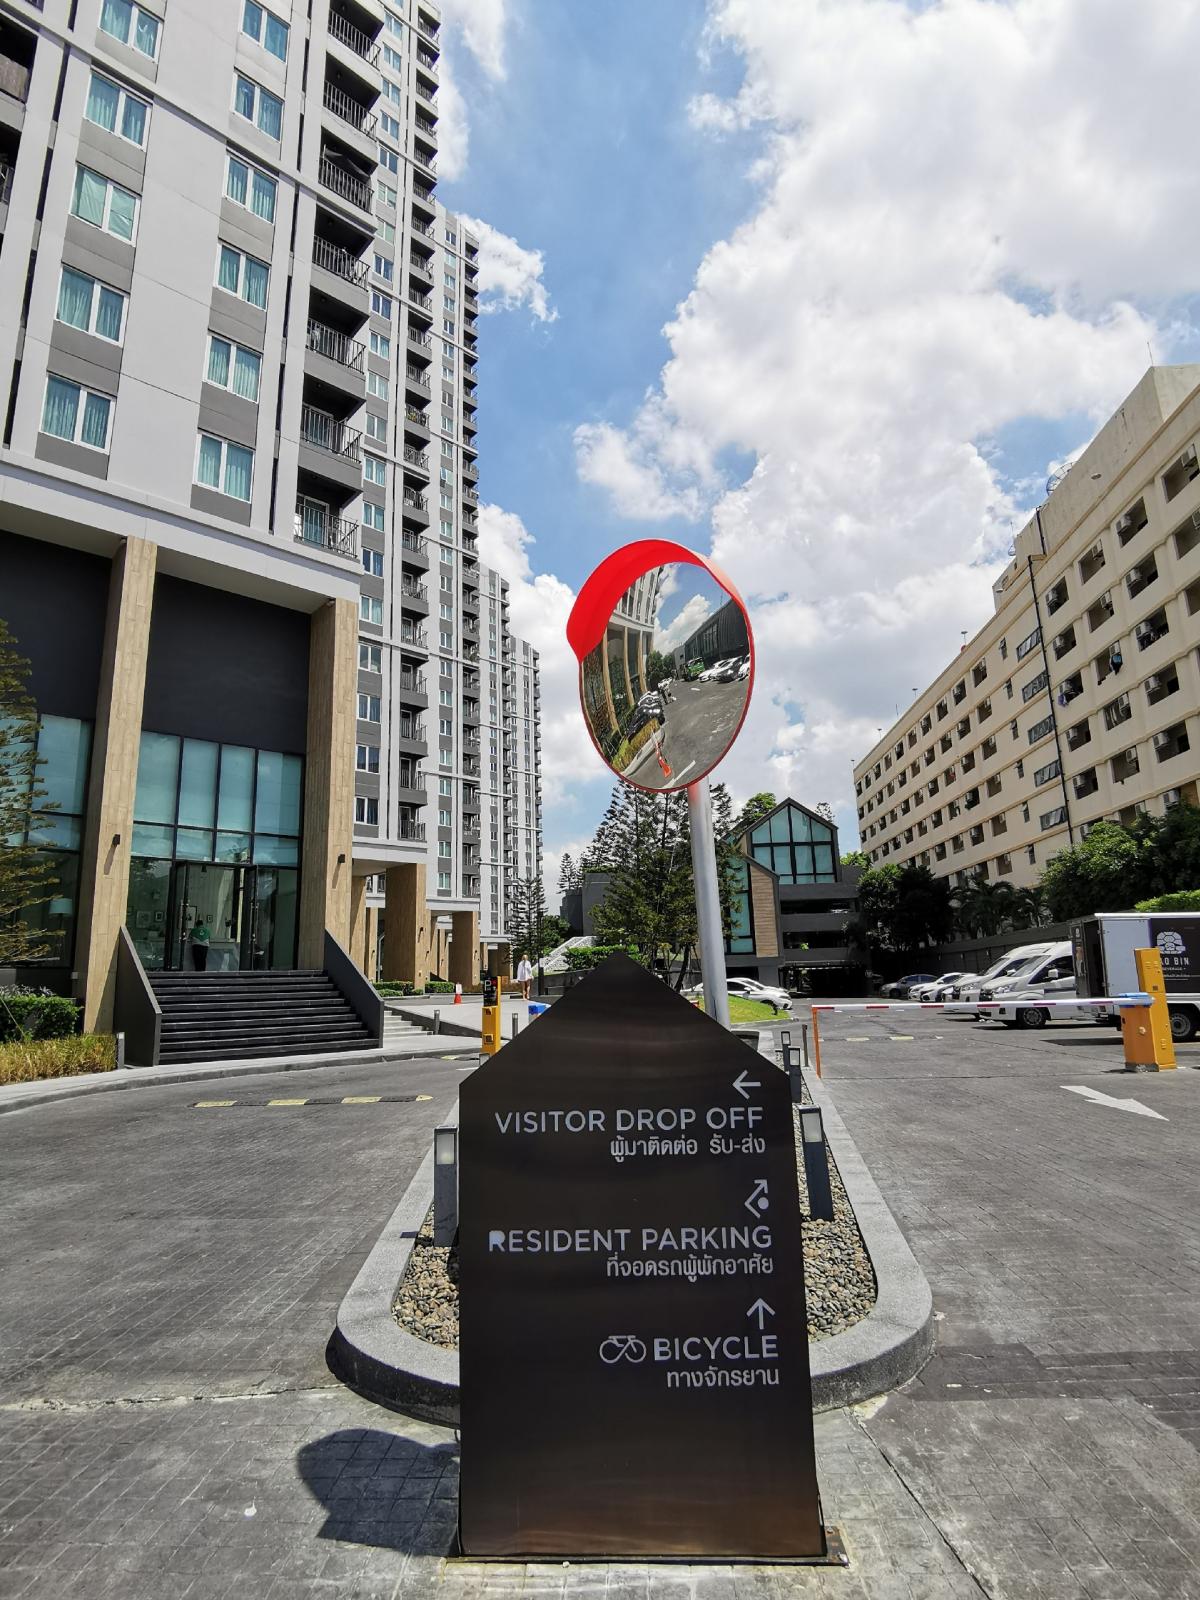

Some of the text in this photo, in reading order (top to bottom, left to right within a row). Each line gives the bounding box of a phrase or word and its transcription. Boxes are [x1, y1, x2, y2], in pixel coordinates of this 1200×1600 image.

[1173, 956, 1189, 966] BIN
[495, 1106, 763, 1134] VISITOR DROP OFF
[610, 1133, 766, 1163] ผู้มาติดต่อ รับ-ส่ง
[488, 1226, 772, 1252] RESIDENT PARKING
[606, 1252, 774, 1283] ที่จอดรถผู้พักอาศัย
[653, 1335, 779, 1361] BICYCLE
[666, 1366, 780, 1388] ทางจักรยาน
